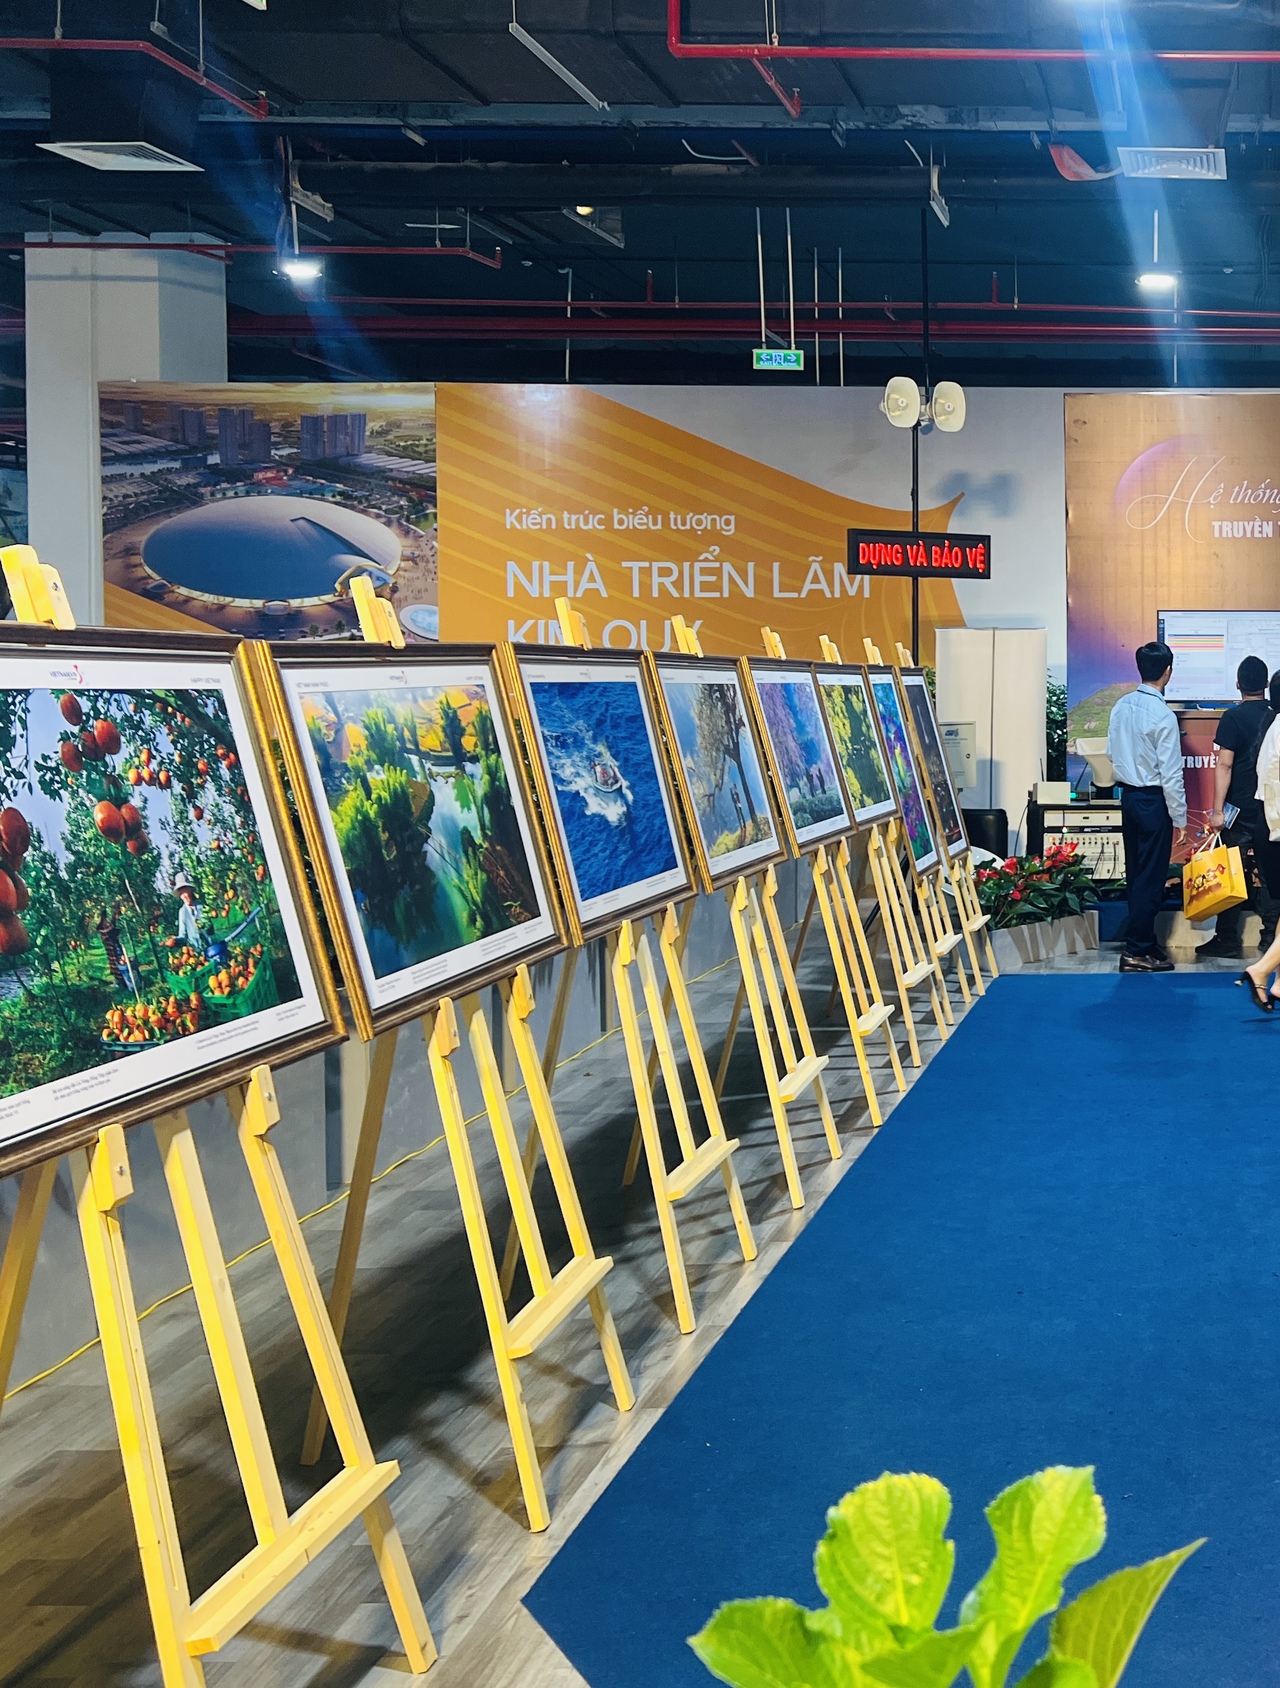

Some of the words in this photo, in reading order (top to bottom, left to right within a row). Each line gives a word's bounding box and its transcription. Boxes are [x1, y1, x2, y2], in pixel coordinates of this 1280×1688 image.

[1125, 455, 1227, 544] Hệ
[505, 507, 556, 531] Kiến
[562, 510, 606, 531] trúc
[612, 505, 662, 531] biểu
[669, 510, 736, 536] tượng
[1211, 515, 1274, 539] TRUYỀN
[506, 553, 608, 598] NHÀ
[621, 545, 755, 598] TRIỂN
[772, 555, 871, 599] LÃM
[858, 542, 903, 570] DỰNG
[907, 540, 929, 568] VÀ
[931, 540, 963, 570] BẢO
[966, 543, 987, 573] VỆ
[602, 619, 704, 653] QU
